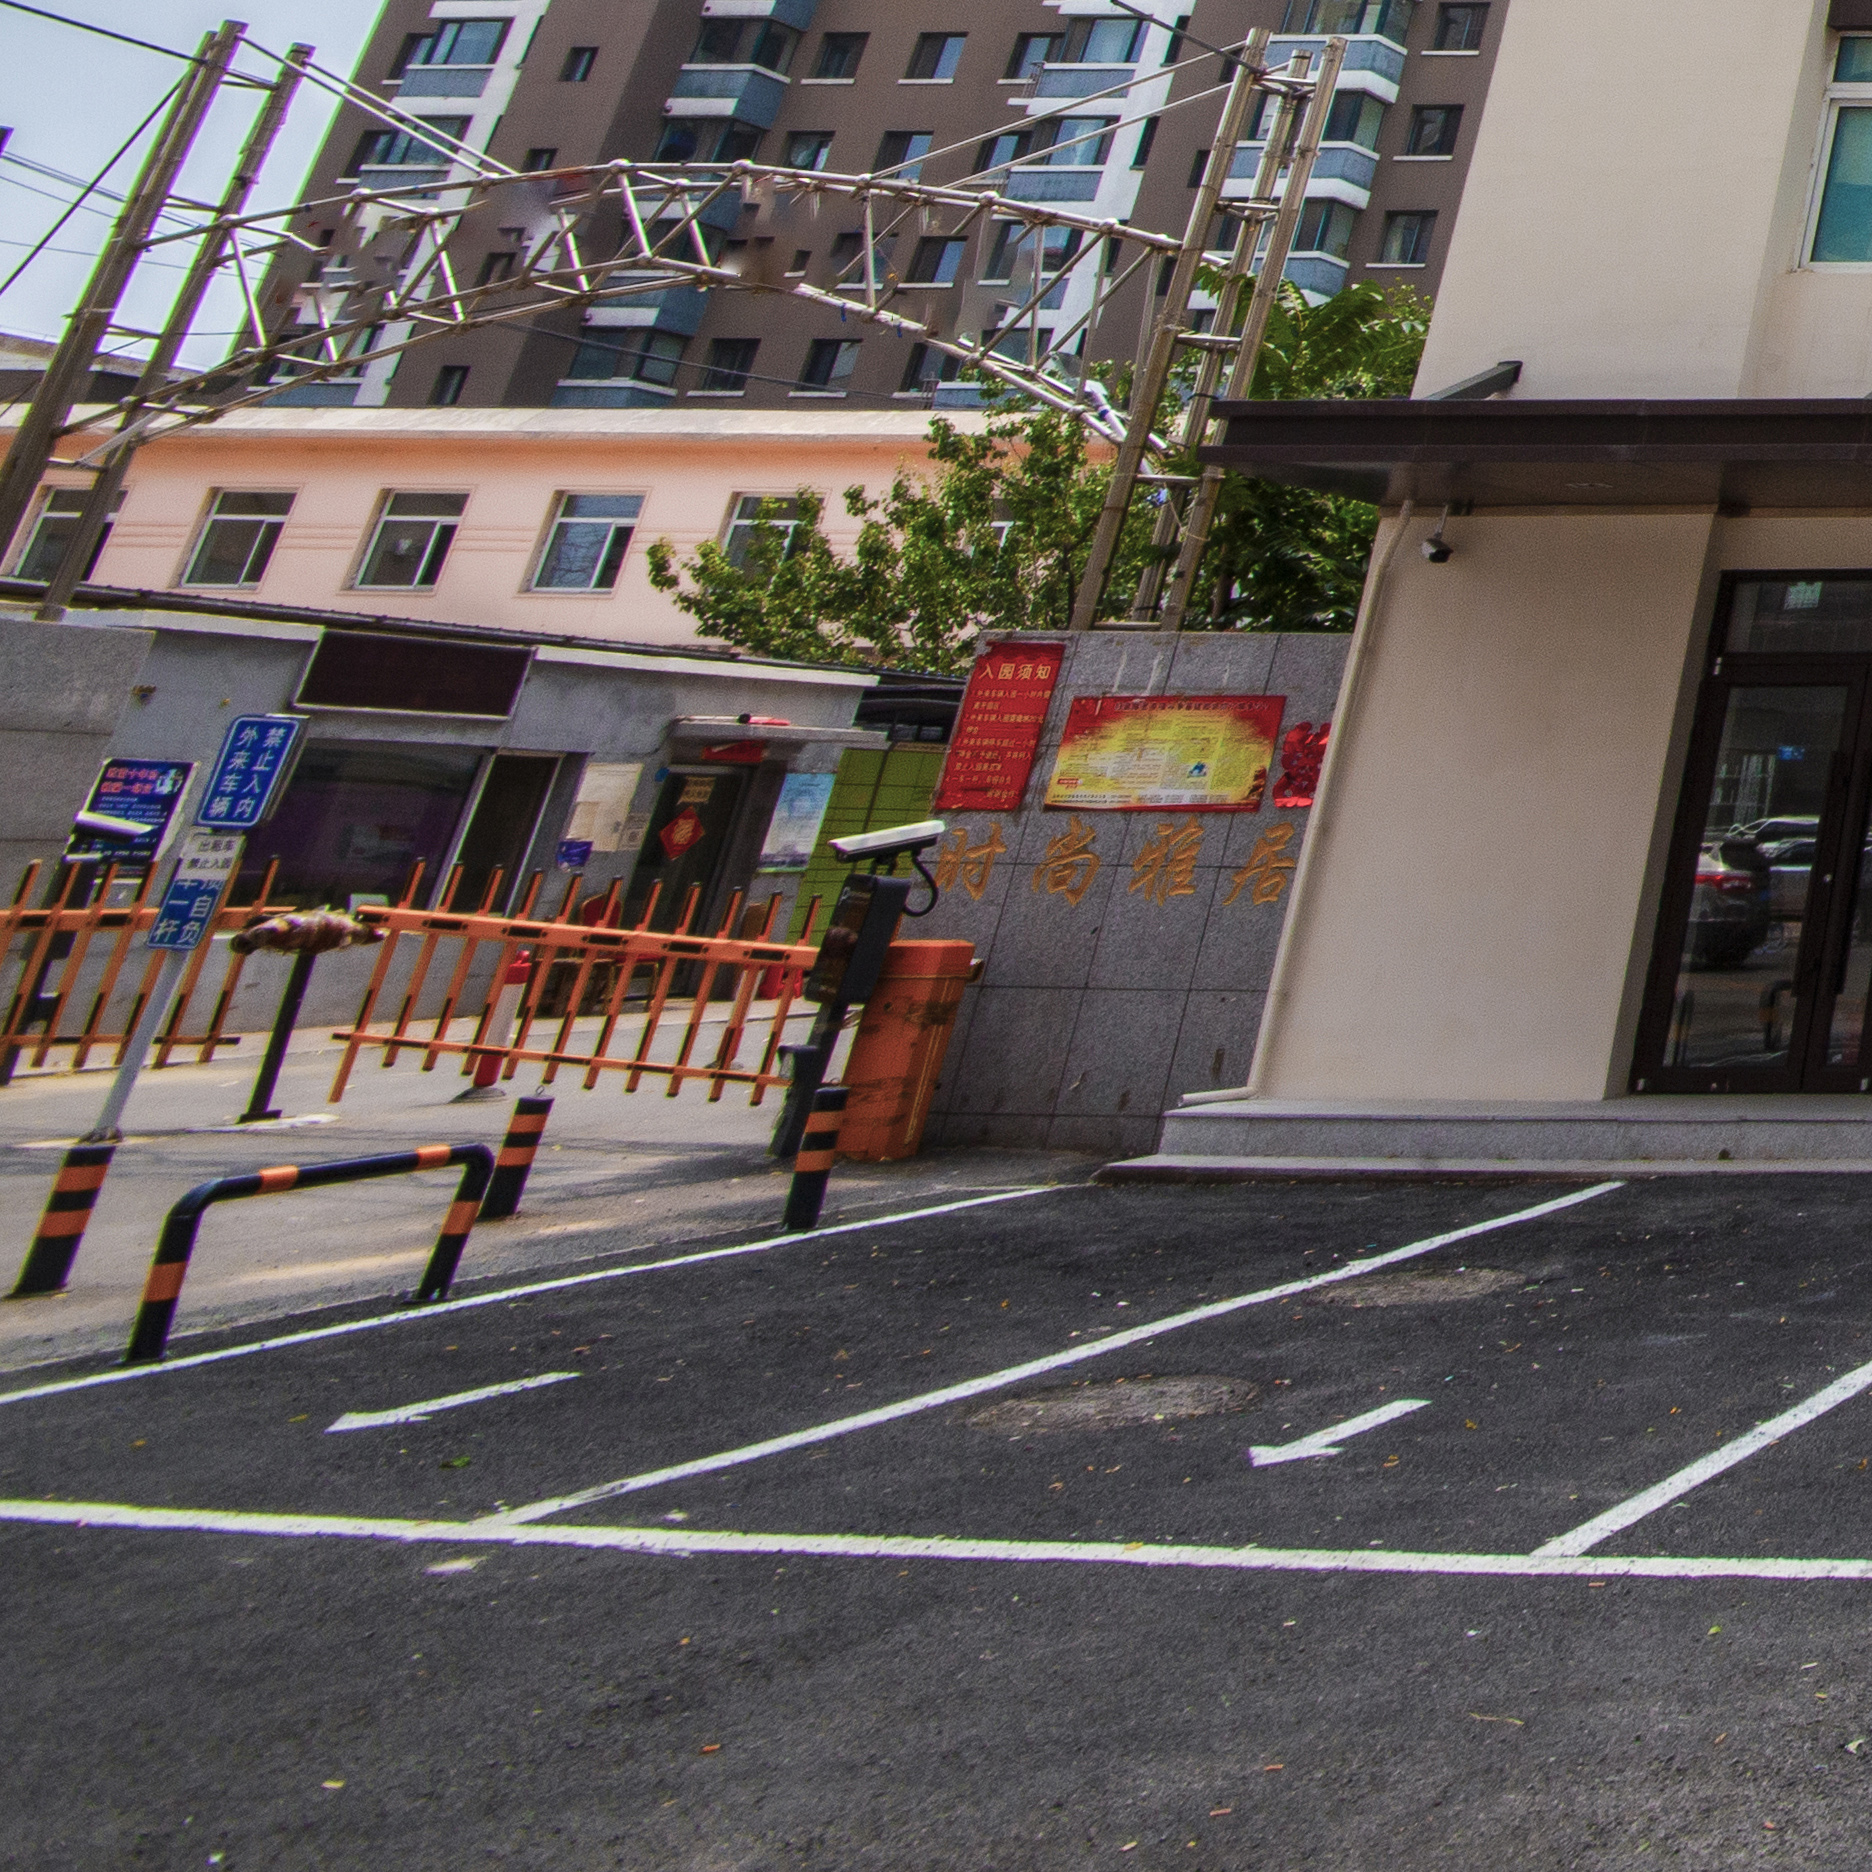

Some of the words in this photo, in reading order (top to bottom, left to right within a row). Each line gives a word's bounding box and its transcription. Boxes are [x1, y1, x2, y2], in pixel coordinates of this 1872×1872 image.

[979, 663, 1051, 680] 入园须知
[208, 726, 258, 818] 外来车辆
[233, 727, 287, 818] 禁止入内
[934, 816, 1295, 906] 时尚雅居
